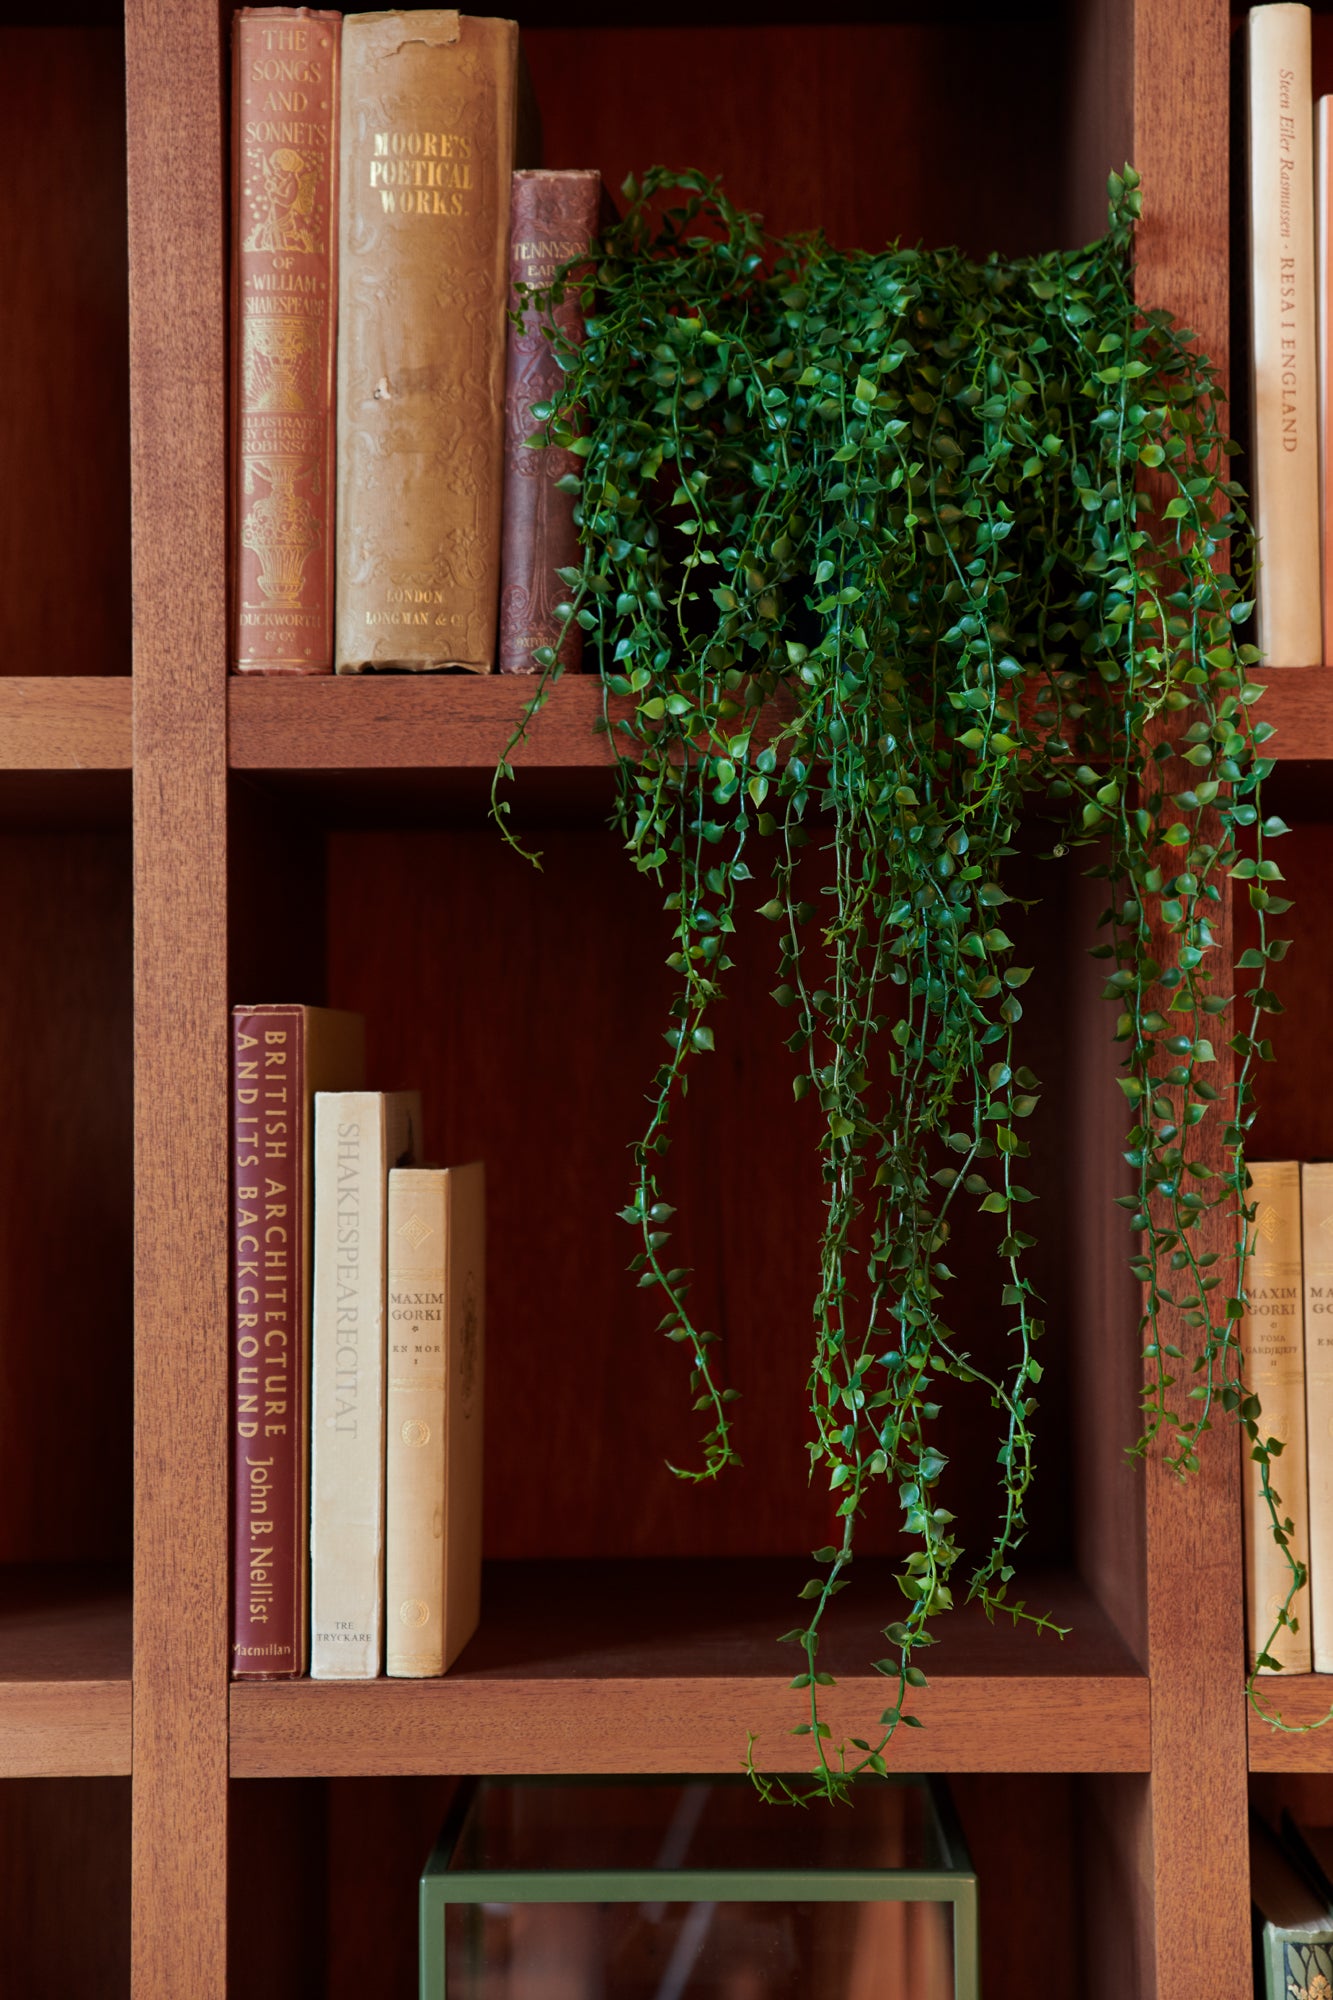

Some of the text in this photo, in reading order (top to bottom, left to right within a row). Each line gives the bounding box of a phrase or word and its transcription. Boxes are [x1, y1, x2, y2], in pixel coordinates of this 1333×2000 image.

[262, 30, 308, 51] THE
[252, 60, 322, 83] SONGS
[1279, 69, 1295, 109] Steen
[262, 92, 309, 112] AND
[245, 121, 327, 145] SONNETS
[1279, 115, 1297, 152] Eiler
[373, 132, 472, 159] MOORE'S
[370, 160, 474, 190] POETICAL
[379, 189, 470, 216] WORKS.
[1279, 158, 1295, 237] Rasmussen
[271, 256, 295, 270] OF
[252, 273, 317, 293] WILLIAM
[1280, 257, 1295, 312] RESA
[244, 295, 325, 317] SHAKESPEARE
[1281, 337, 1298, 452] ENGLAND
[242, 429, 257, 440] BY
[386, 590, 443, 604] LONDON
[240, 612, 321, 628] DUCKWORTH
[365, 611, 429, 625] LONGMAN
[435, 612, 447, 626] &
[264, 631, 276, 642] &
[236, 1032, 260, 1439] AND ITS BACKGROUND
[264, 1030, 288, 1438] BRITISH ARCHITECTURE
[335, 1123, 361, 1440] SHAKESPEARECITAT
[390, 1292, 445, 1305] MAXIM
[1245, 1287, 1298, 1300] MAXIM
[391, 1308, 442, 1321] GORKI
[1247, 1302, 1297, 1316] GORKI
[392, 1344, 441, 1353] EN MOR
[245, 1456, 274, 1624] John B. Nellist
[335, 1621, 354, 1630] TRE
[317, 1632, 372, 1642] TRYCKARE
[233, 1643, 291, 1657] Macmillan
